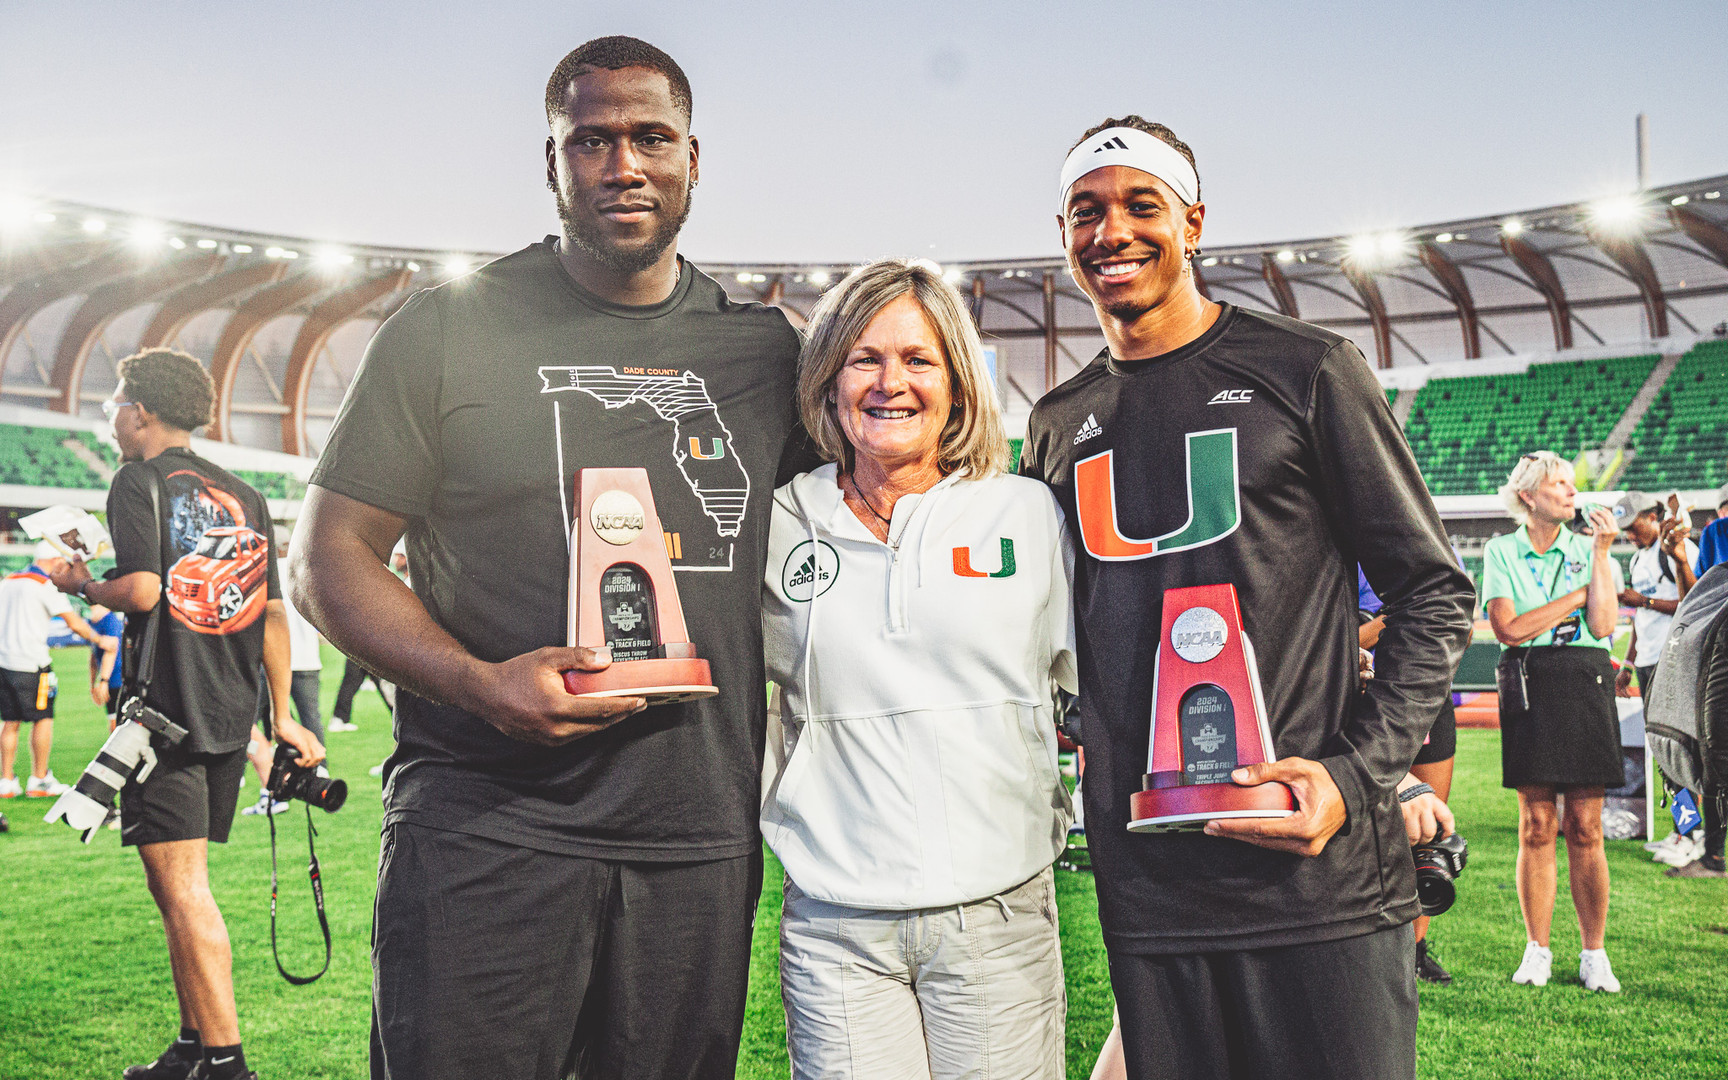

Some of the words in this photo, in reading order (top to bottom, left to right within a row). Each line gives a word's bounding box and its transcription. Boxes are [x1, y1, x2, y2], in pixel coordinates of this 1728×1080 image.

[623, 366, 645, 375] DADE
[646, 367, 679, 376] COUNTY
[1207, 389, 1254, 405] ACC
[1073, 426, 1103, 446] adidas
[688, 436, 725, 460] U
[1075, 427, 1242, 562] U
[596, 514, 643, 530] NCAA
[709, 547, 724, 559] 24
[952, 537, 1017, 578] U
[611, 576, 632, 585] 2024
[604, 583, 635, 594] DIVISION
[637, 639, 652, 647] FIELD
[1176, 630, 1225, 649] NCAA
[1196, 696, 1218, 706] 2024
[1188, 703, 1222, 715] DIVISION
[1196, 763, 1214, 771] TRACK
